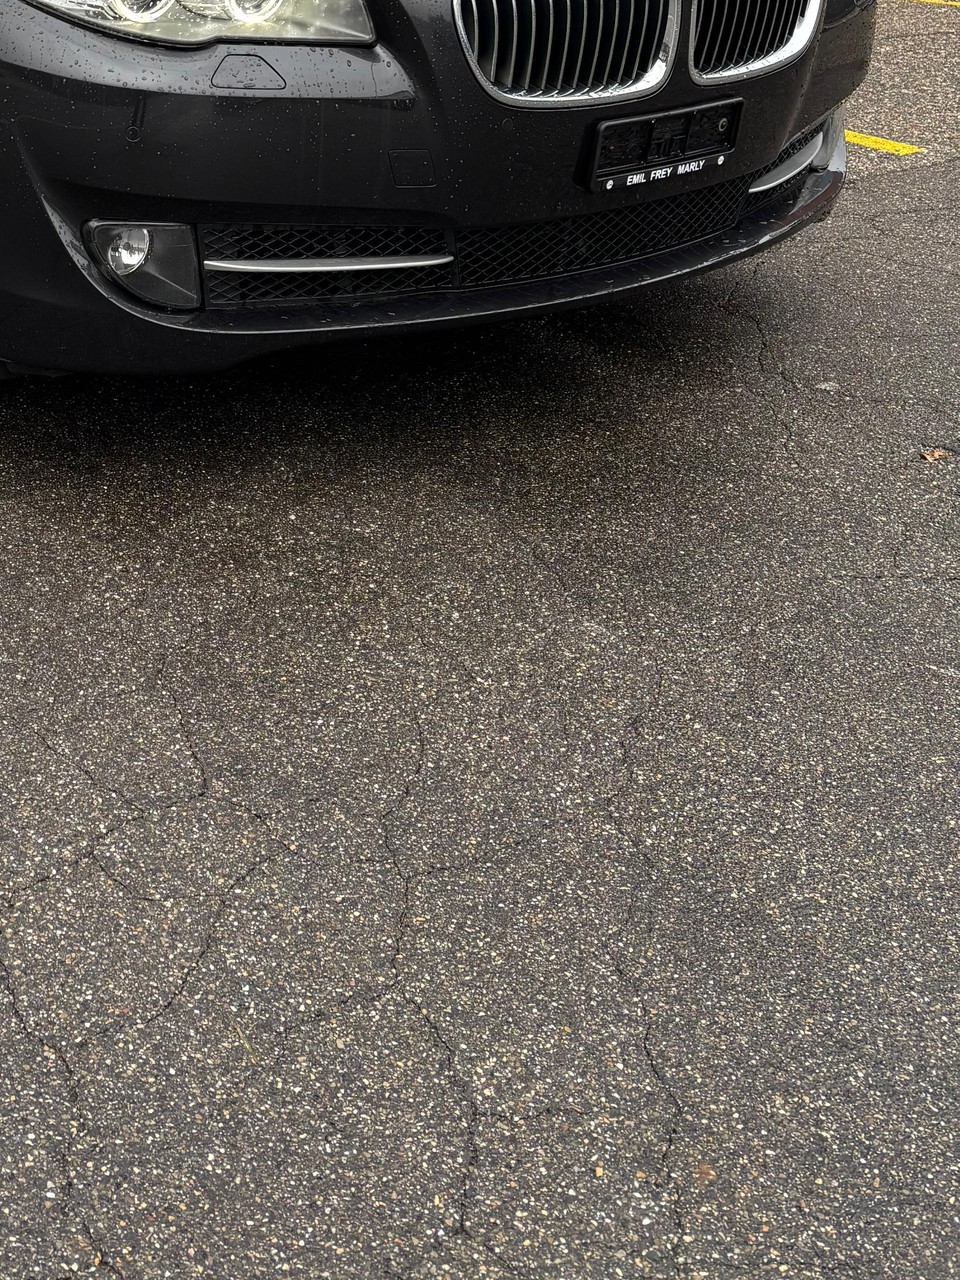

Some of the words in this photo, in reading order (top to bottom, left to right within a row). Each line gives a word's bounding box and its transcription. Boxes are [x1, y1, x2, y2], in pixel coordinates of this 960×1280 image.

[626, 172, 647, 186] EMIL
[650, 166, 673, 181] FREY
[677, 160, 706, 175] MARLY
